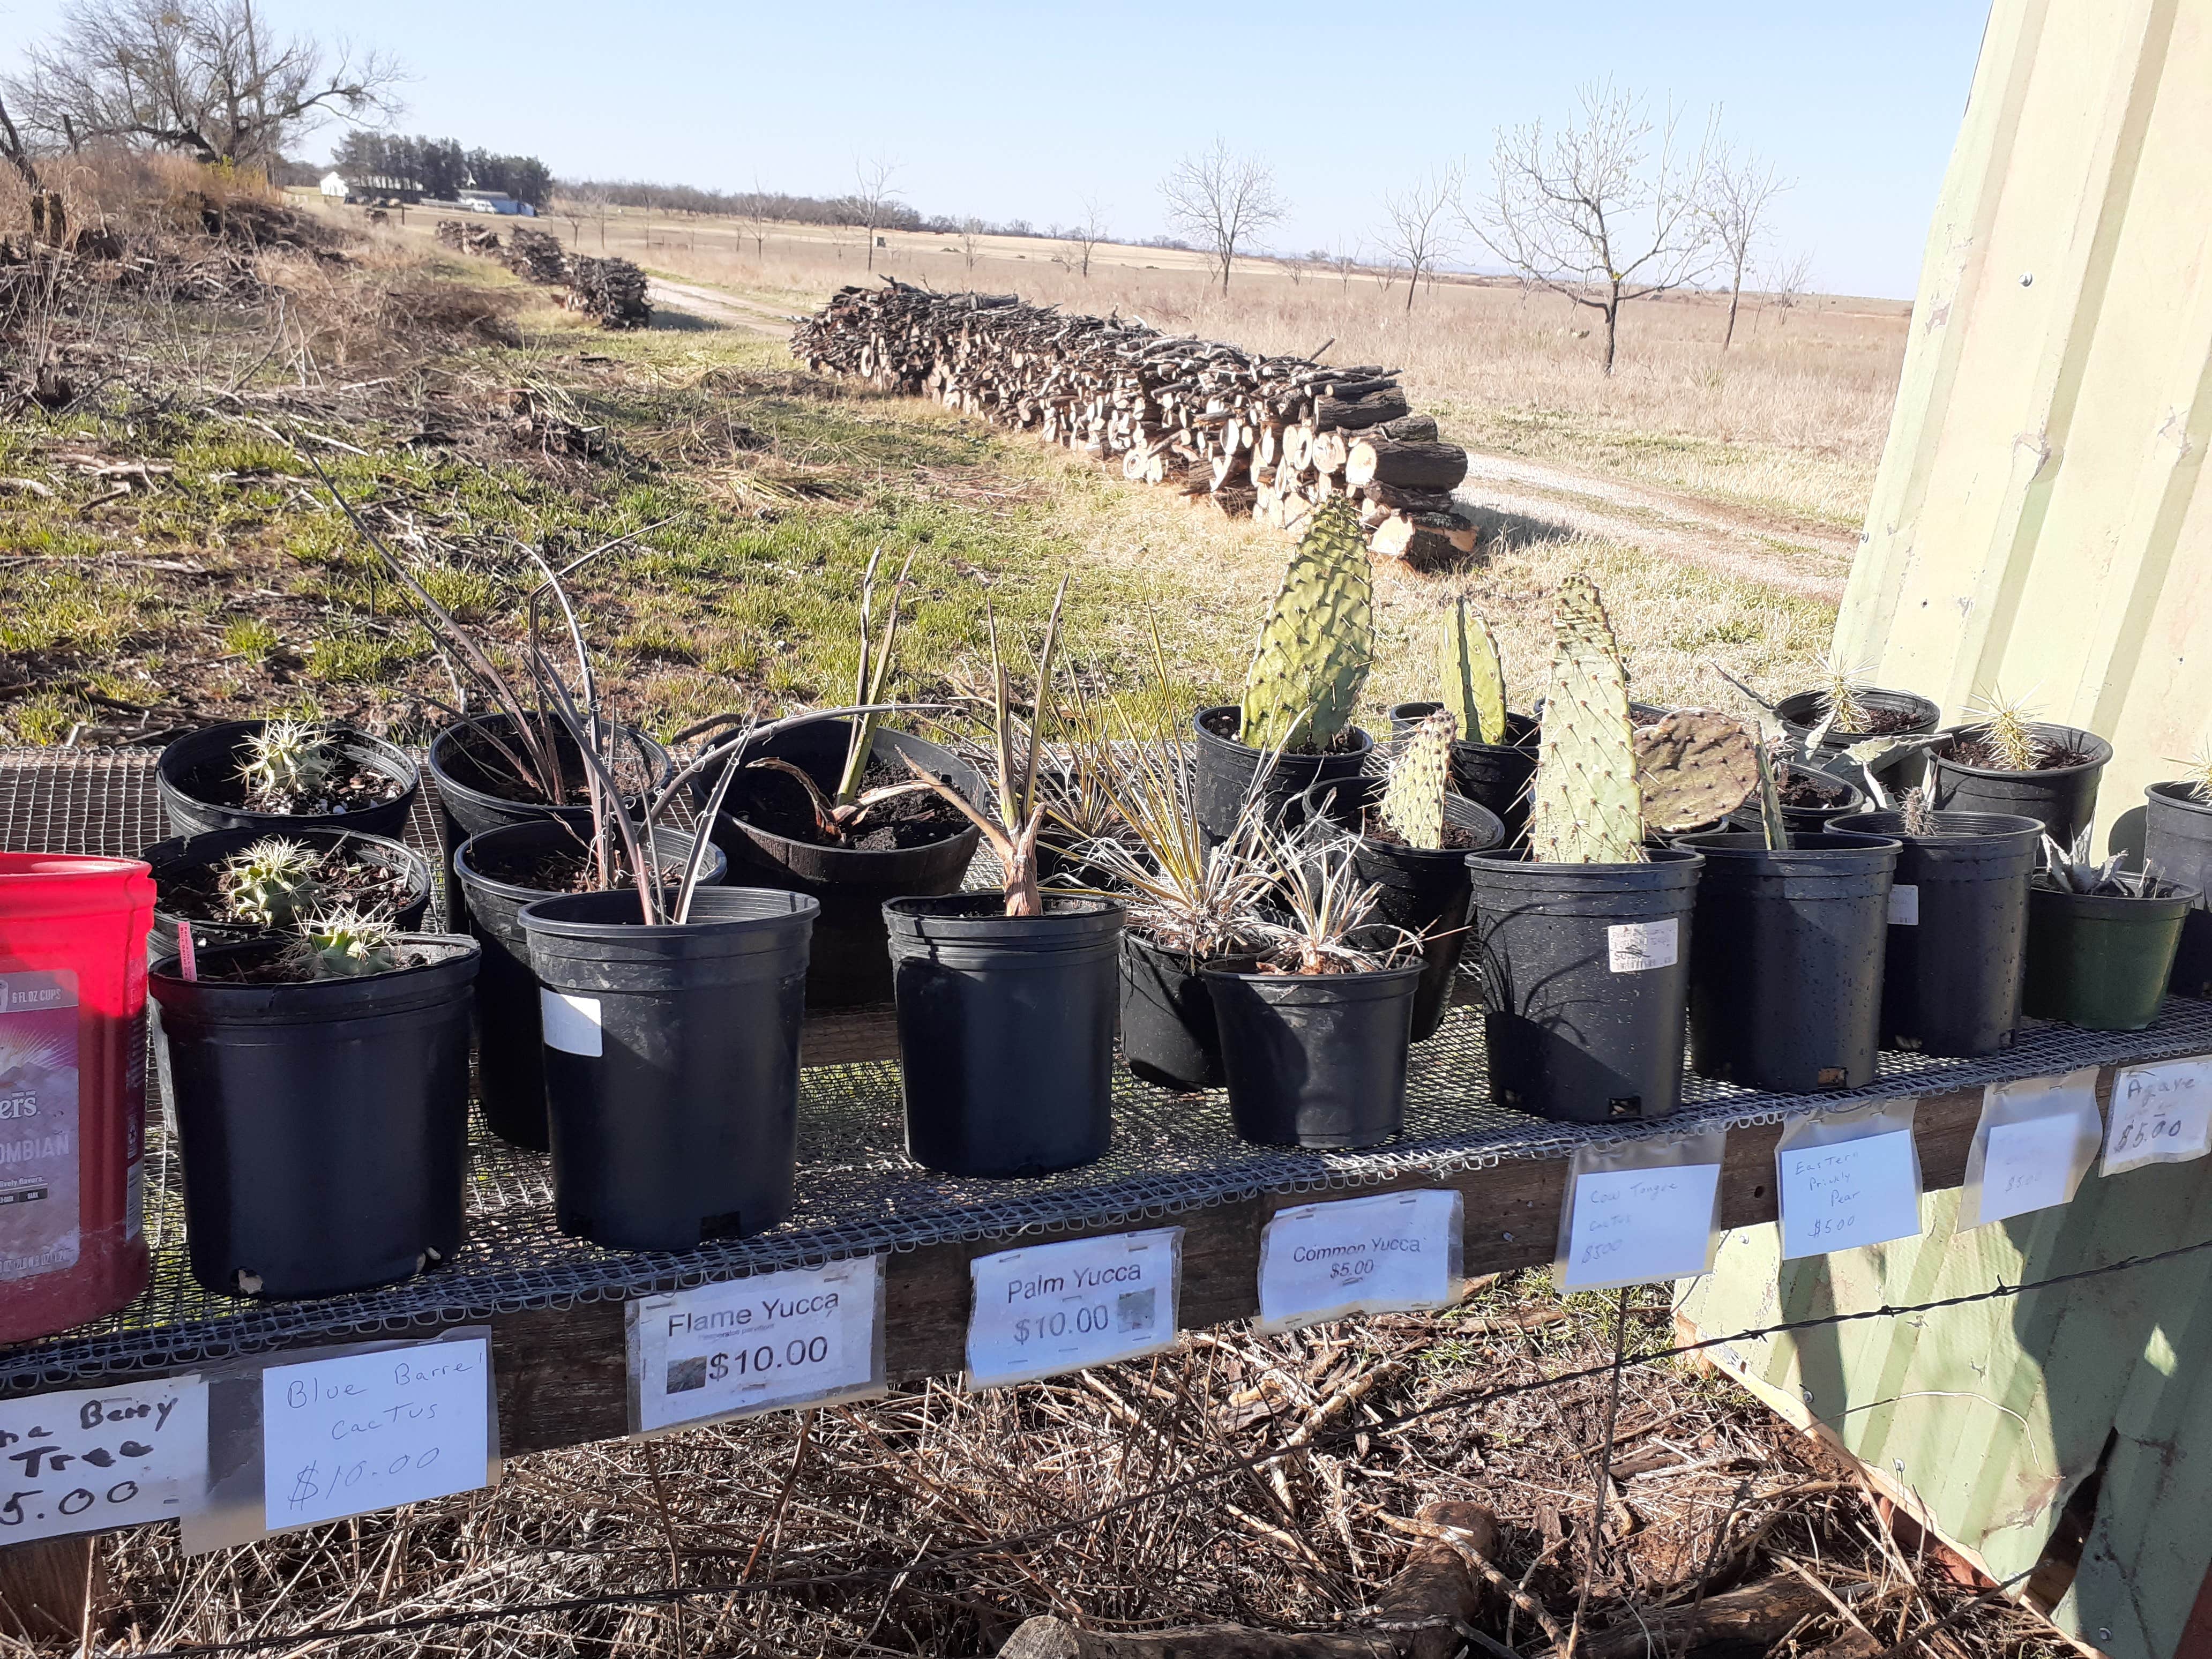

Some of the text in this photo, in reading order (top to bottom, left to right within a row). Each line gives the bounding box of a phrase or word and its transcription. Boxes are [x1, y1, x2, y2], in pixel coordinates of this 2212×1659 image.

[12, 992, 17, 1004] 6
[18, 991, 27, 1003] FL
[40, 989, 61, 1001] CUPS
[2128, 1079, 2195, 1107] Agave
[1590, 1190, 1620, 1203] Cow
[1831, 1190, 1860, 1207] Pear
[1294, 1237, 1421, 1263] Common Yucca
[1008, 1264, 1141, 1304] Palm Yucca
[1330, 1259, 1374, 1279] $5.00
[669, 1292, 839, 1337] Flame Yucca
[1014, 1304, 1109, 1345] $10.00
[708, 1336, 828, 1381] $10.00
[287, 1352, 482, 1408] Blue Barrel
[80, 1398, 178, 1432] Berry
[9, 1441, 154, 1477] Tree
[288, 1447, 440, 1511] $10.00
